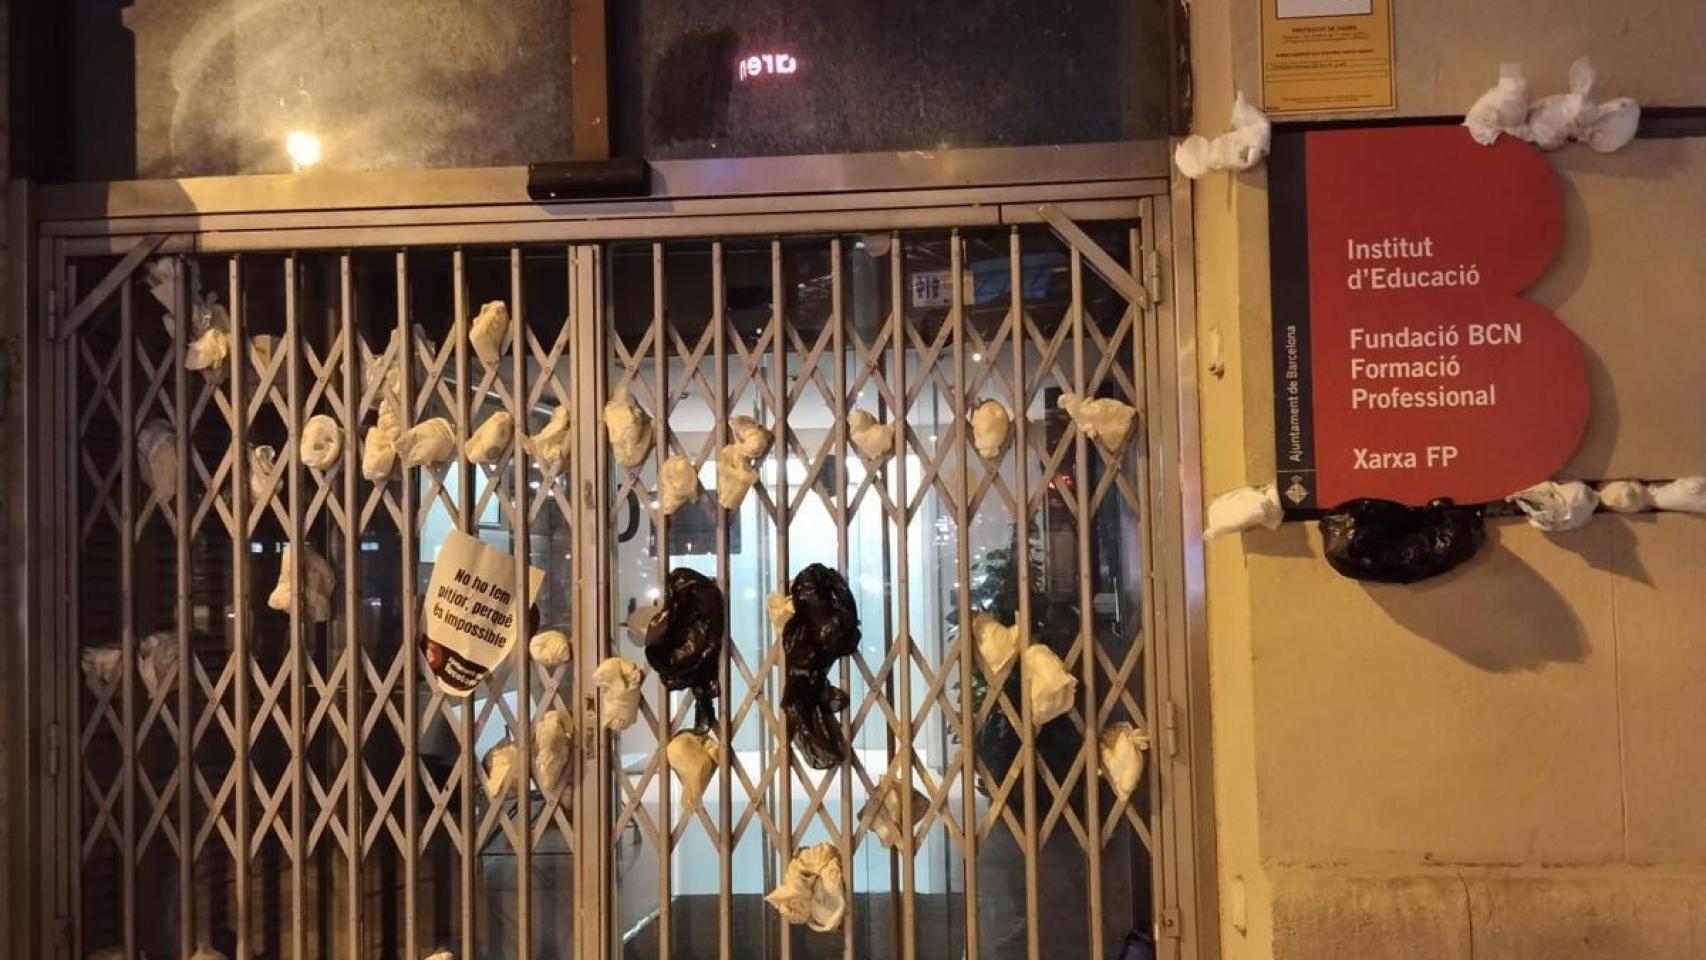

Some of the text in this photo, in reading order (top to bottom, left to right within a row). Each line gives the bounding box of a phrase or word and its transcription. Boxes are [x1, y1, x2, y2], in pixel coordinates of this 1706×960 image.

[1347, 237, 1434, 260] Institut
[1347, 264, 1480, 290] d'Educació
[1349, 323, 1522, 350] Fundació BCN
[1350, 355, 1461, 380] Formació
[1286, 325, 1303, 462] Ajuntament de Barcelona
[1351, 384, 1496, 410] Professional
[1353, 446, 1459, 470] Xarxa FP
[454, 568, 471, 586] No
[472, 576, 487, 594] ho
[444, 611, 507, 648] impossible
